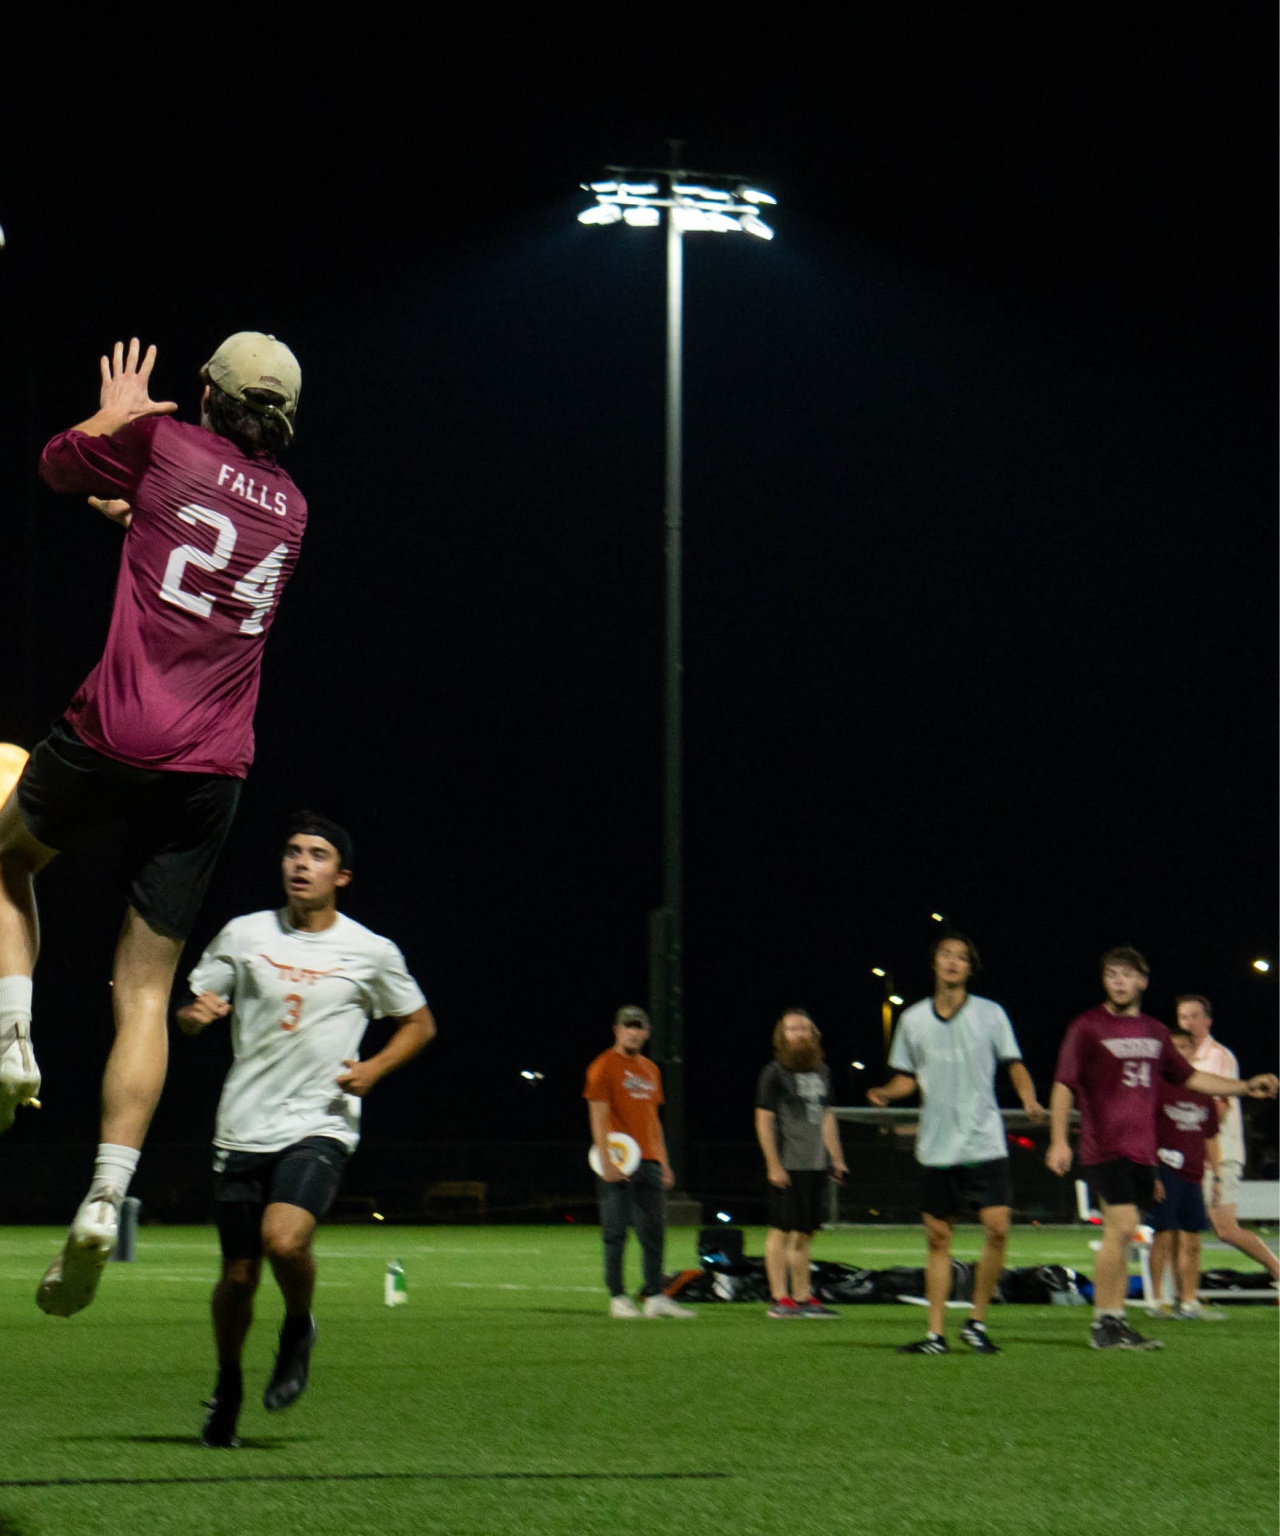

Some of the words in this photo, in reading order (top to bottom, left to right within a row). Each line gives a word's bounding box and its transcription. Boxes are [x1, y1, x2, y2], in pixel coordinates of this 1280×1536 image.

[217, 464, 288, 516] FALLS
[158, 503, 289, 637] 24
[279, 992, 304, 1032] 3
[1122, 1060, 1152, 1088] 54
